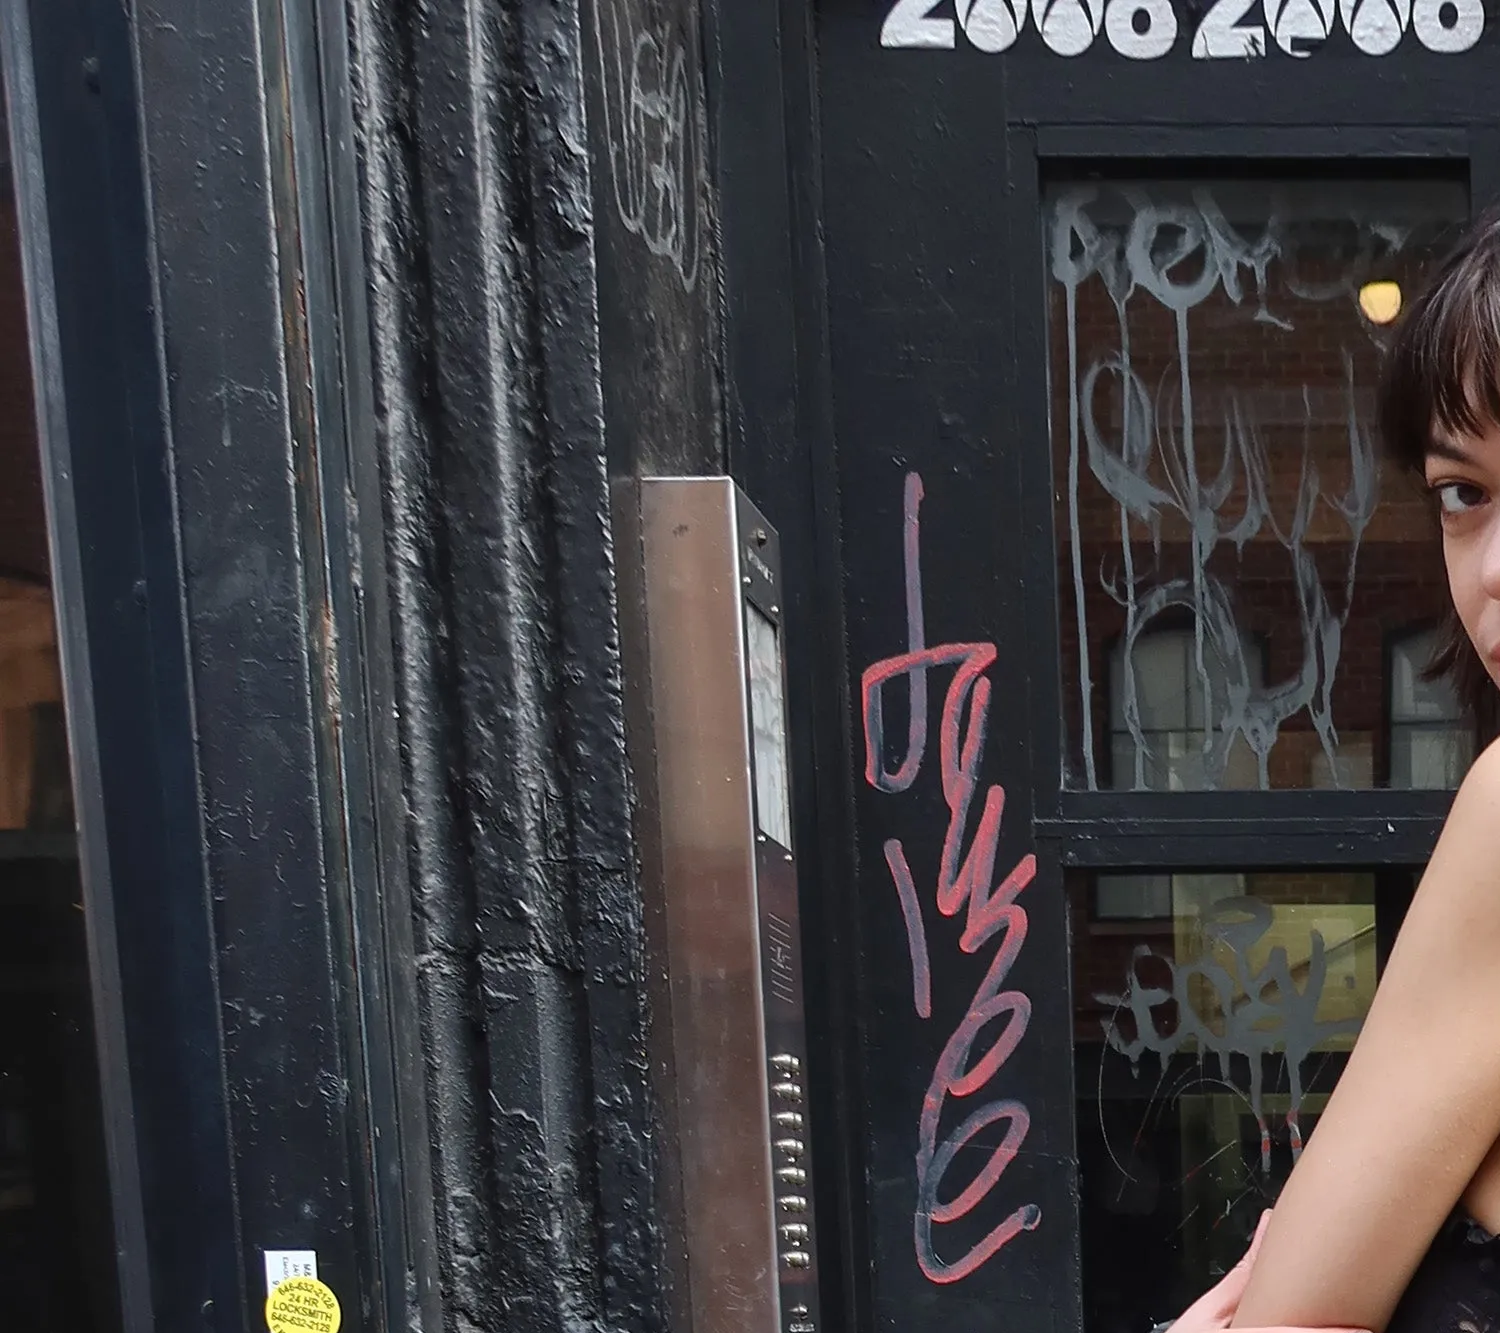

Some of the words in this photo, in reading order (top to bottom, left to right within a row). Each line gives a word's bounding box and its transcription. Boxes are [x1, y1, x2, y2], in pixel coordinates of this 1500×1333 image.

[278, 1281, 335, 1310] 646-632-2128
[288, 1293, 301, 1303] 24
[304, 1294, 319, 1308] HR
[273, 1300, 332, 1322] LOCKSMITH
[271, 1312, 331, 1332] 646-632-2128
